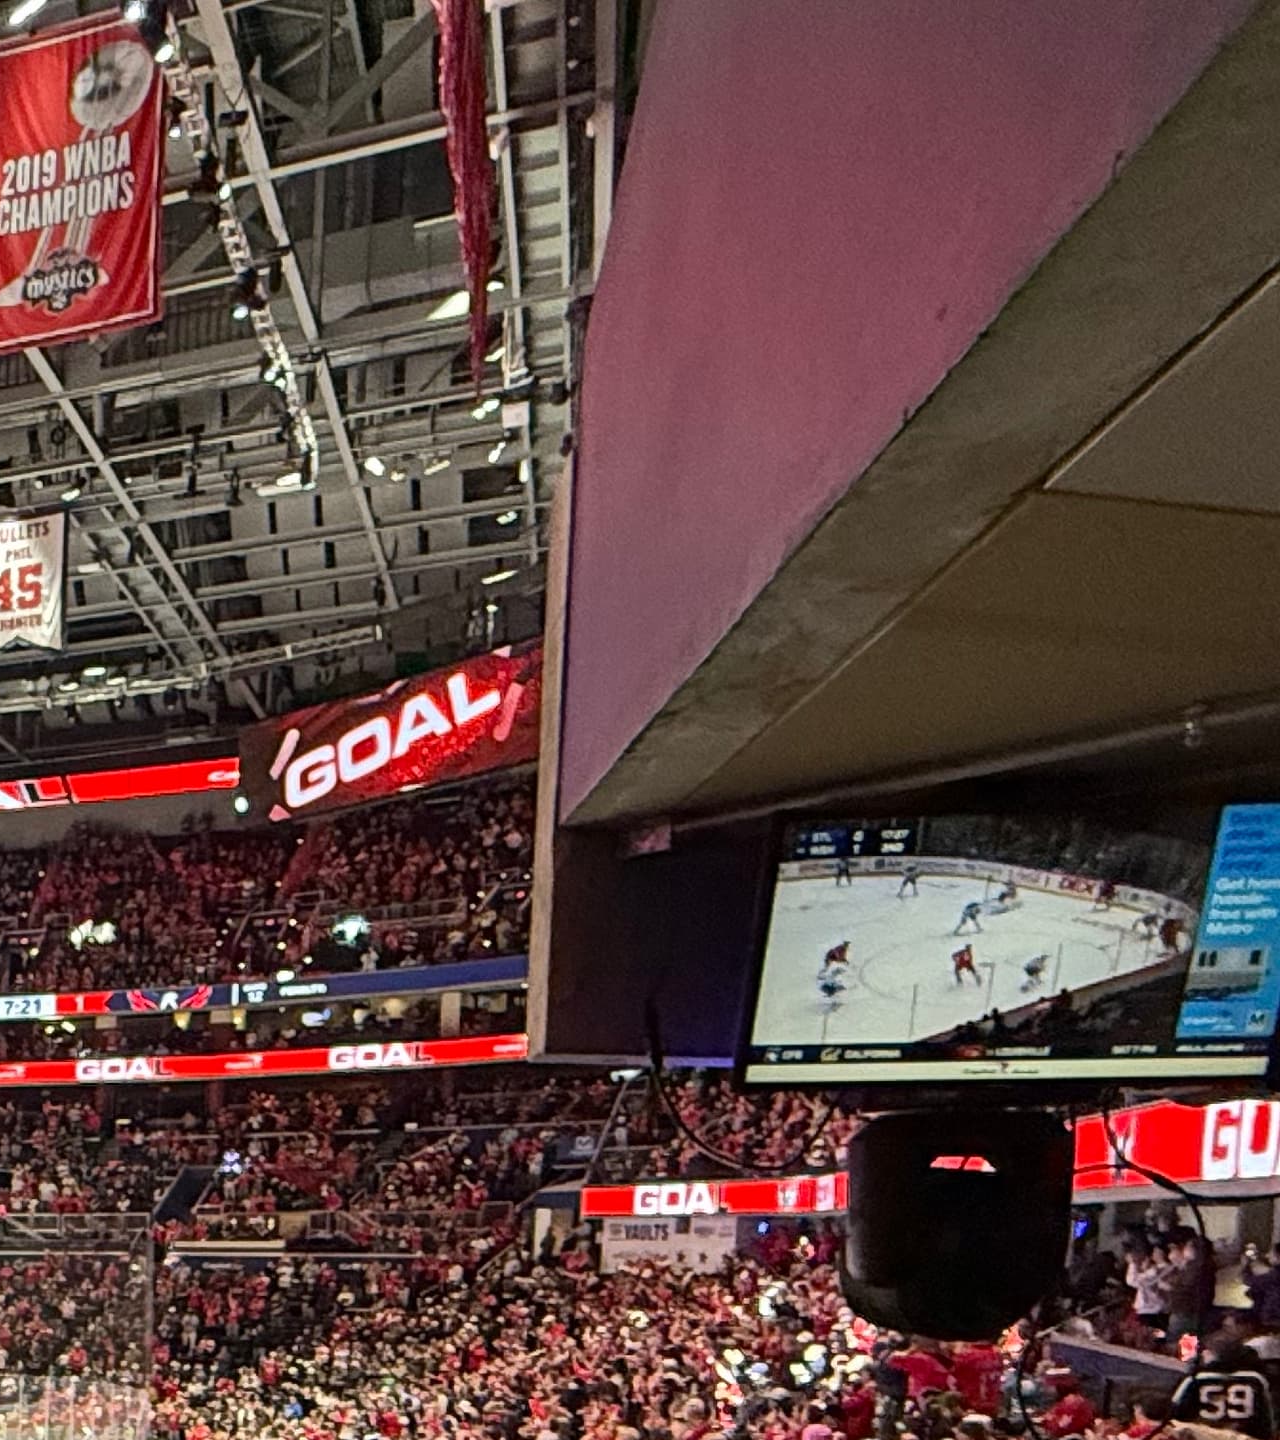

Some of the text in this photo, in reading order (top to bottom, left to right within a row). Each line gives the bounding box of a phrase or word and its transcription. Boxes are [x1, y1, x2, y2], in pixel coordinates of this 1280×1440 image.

[1, 131, 132, 197] 2019 WNBA
[285, 672, 501, 808] GOAL
[76, 1057, 174, 1084] GOAL
[328, 1042, 435, 1070] GOAL
[1199, 1384, 1254, 1420] 59
